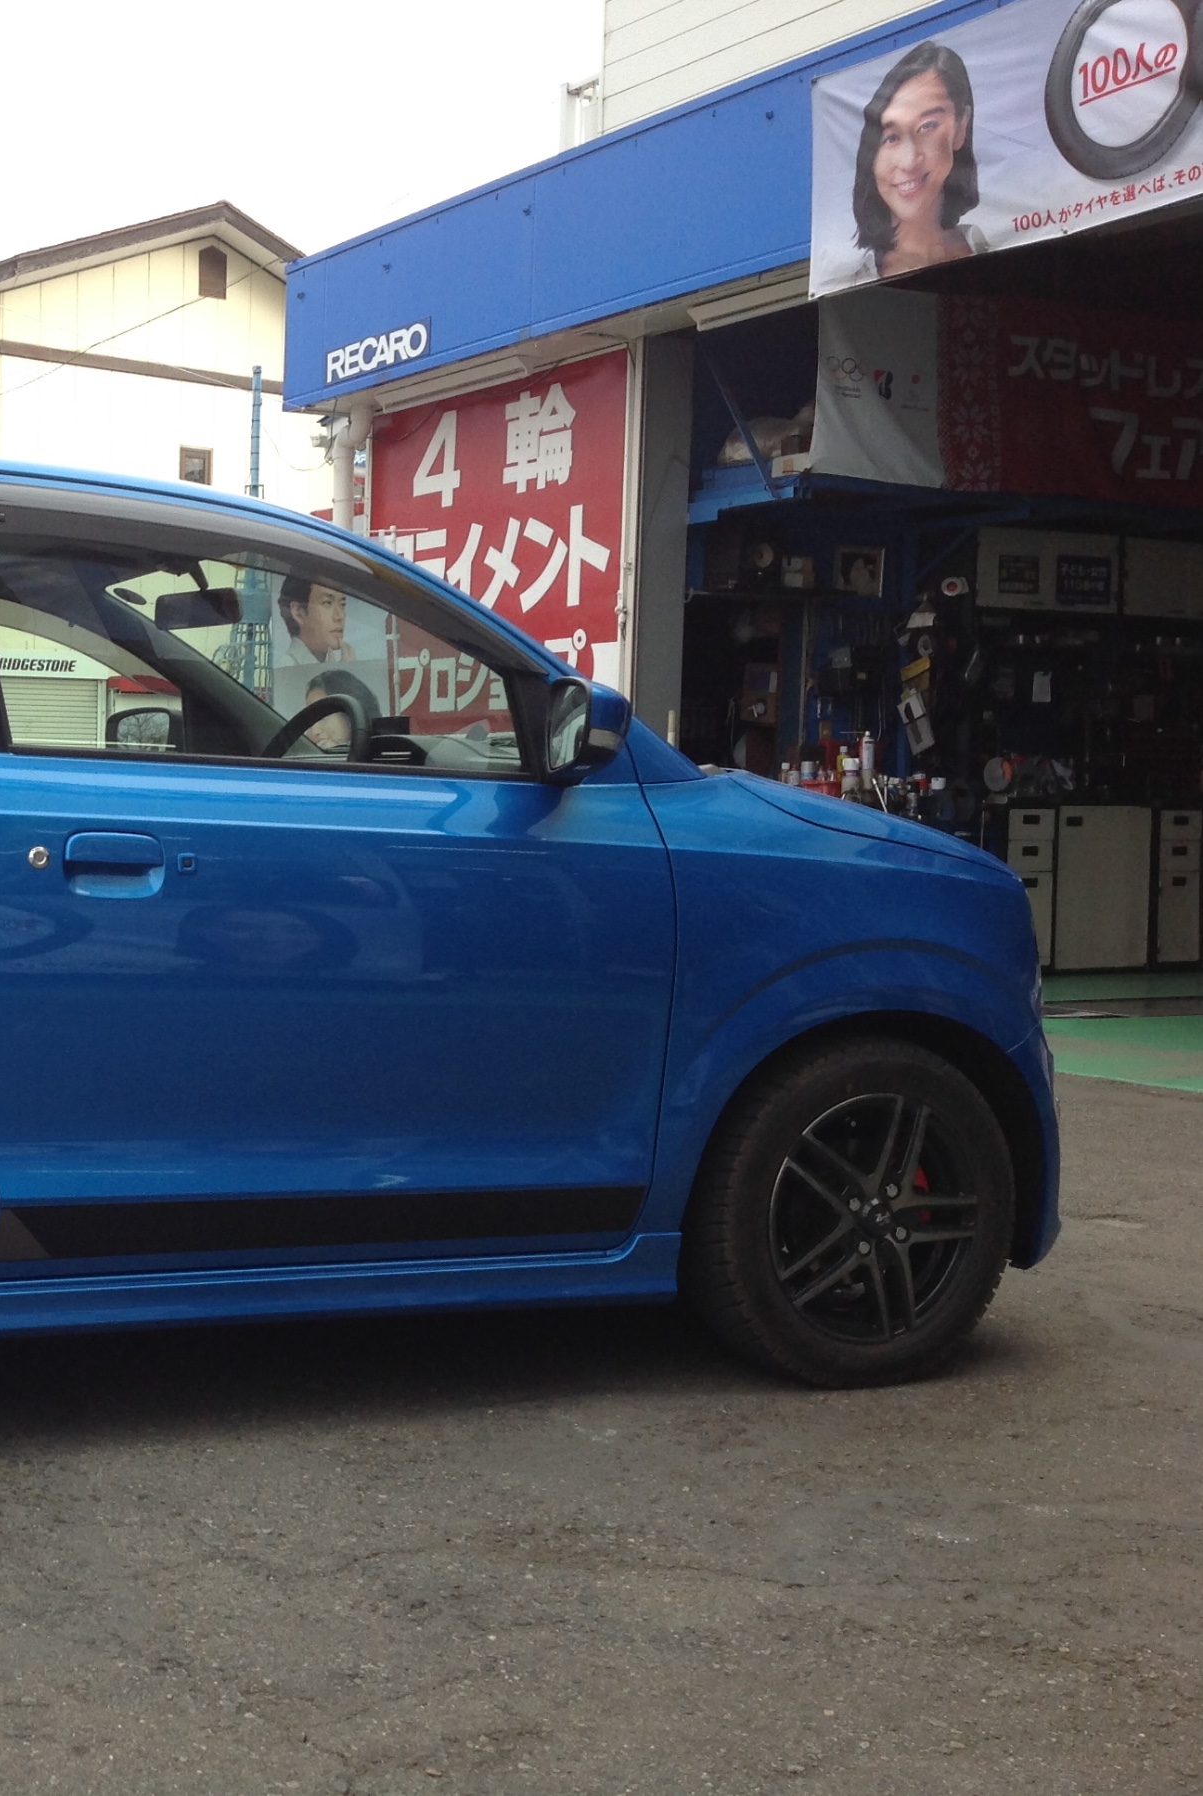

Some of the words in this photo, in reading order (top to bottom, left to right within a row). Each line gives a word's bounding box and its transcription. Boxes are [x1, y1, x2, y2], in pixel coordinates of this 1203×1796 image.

[1079, 42, 1178, 99] 100人の
[1012, 163, 1203, 232] 100人がタイヤを選べば、その
[327, 321, 428, 383] RECARO
